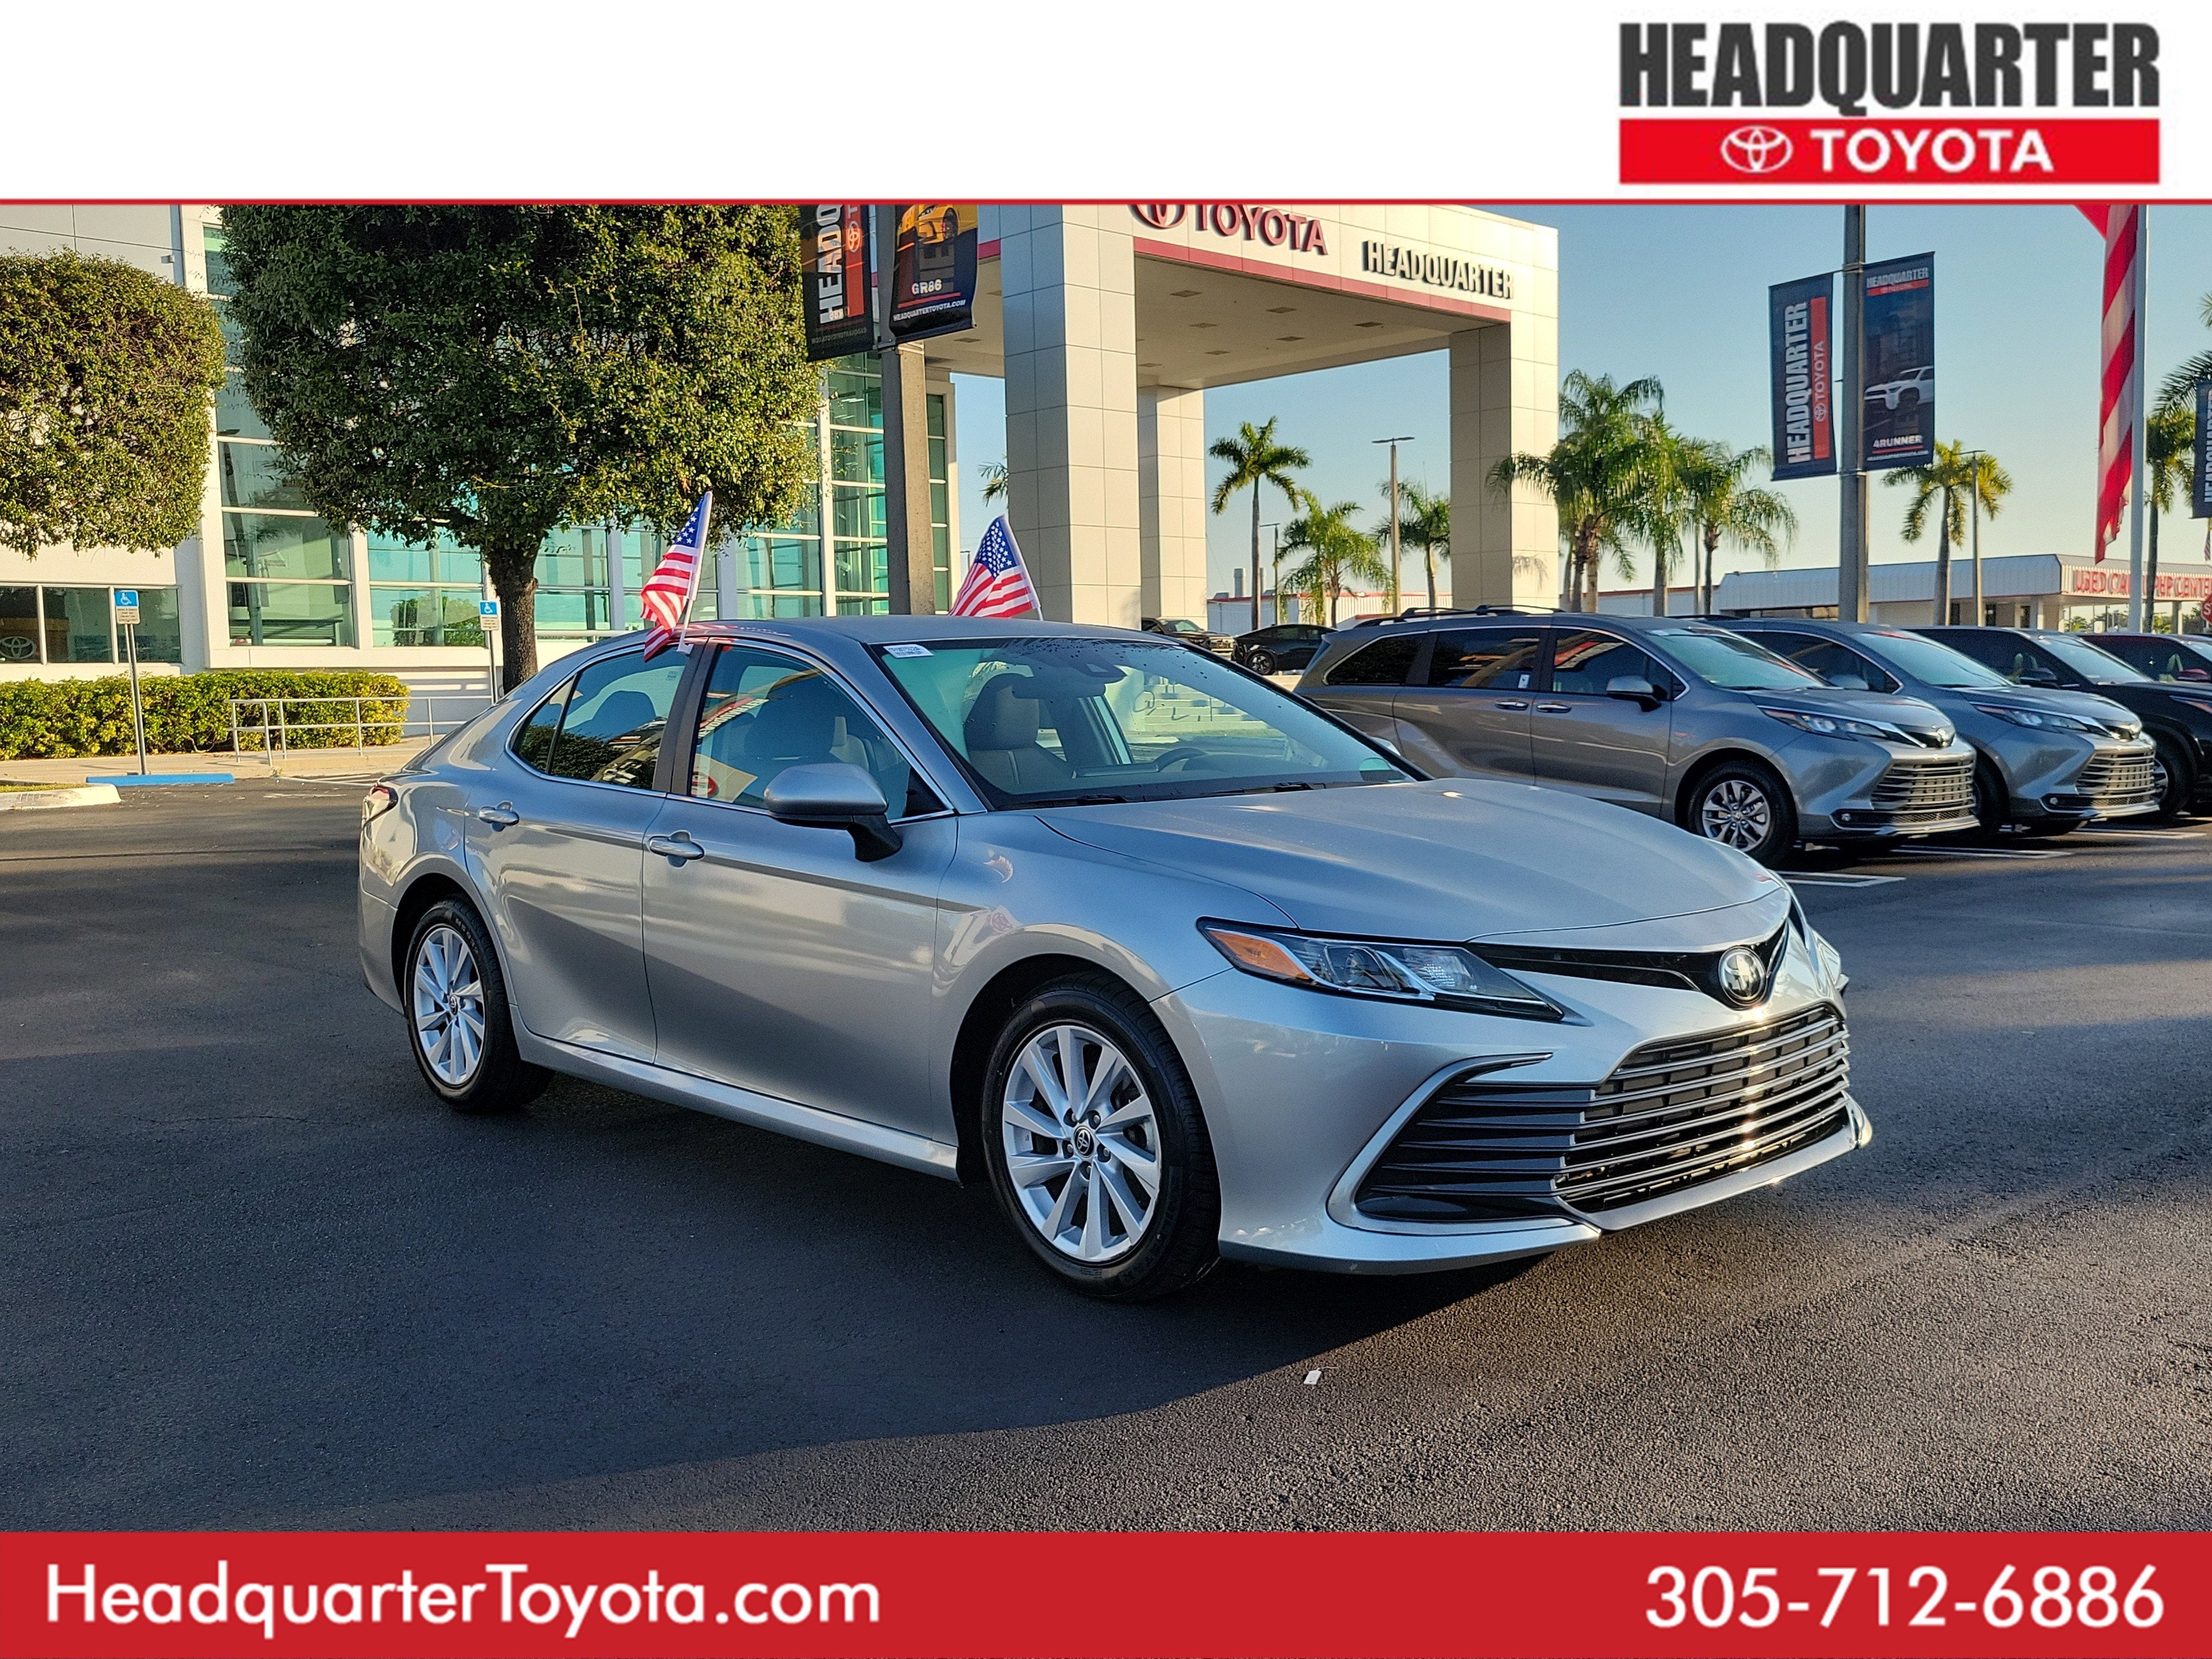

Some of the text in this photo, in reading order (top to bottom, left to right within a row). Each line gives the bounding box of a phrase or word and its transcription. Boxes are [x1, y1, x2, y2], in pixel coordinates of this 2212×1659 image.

[1363, 240, 1514, 299] HEADQUARTER
[1866, 267, 1928, 289] HEADQUARTER
[912, 279, 942, 295] GR86
[893, 299, 966, 321] HEADQUARTERTOYOTA.COM
[1785, 302, 1812, 464] HEADQUARTER
[1814, 340, 1826, 401] TOYOTA
[1873, 435, 1923, 448] 4RUNNER
[2075, 570, 2107, 592] USED
[2175, 576, 2212, 598] CENTE
